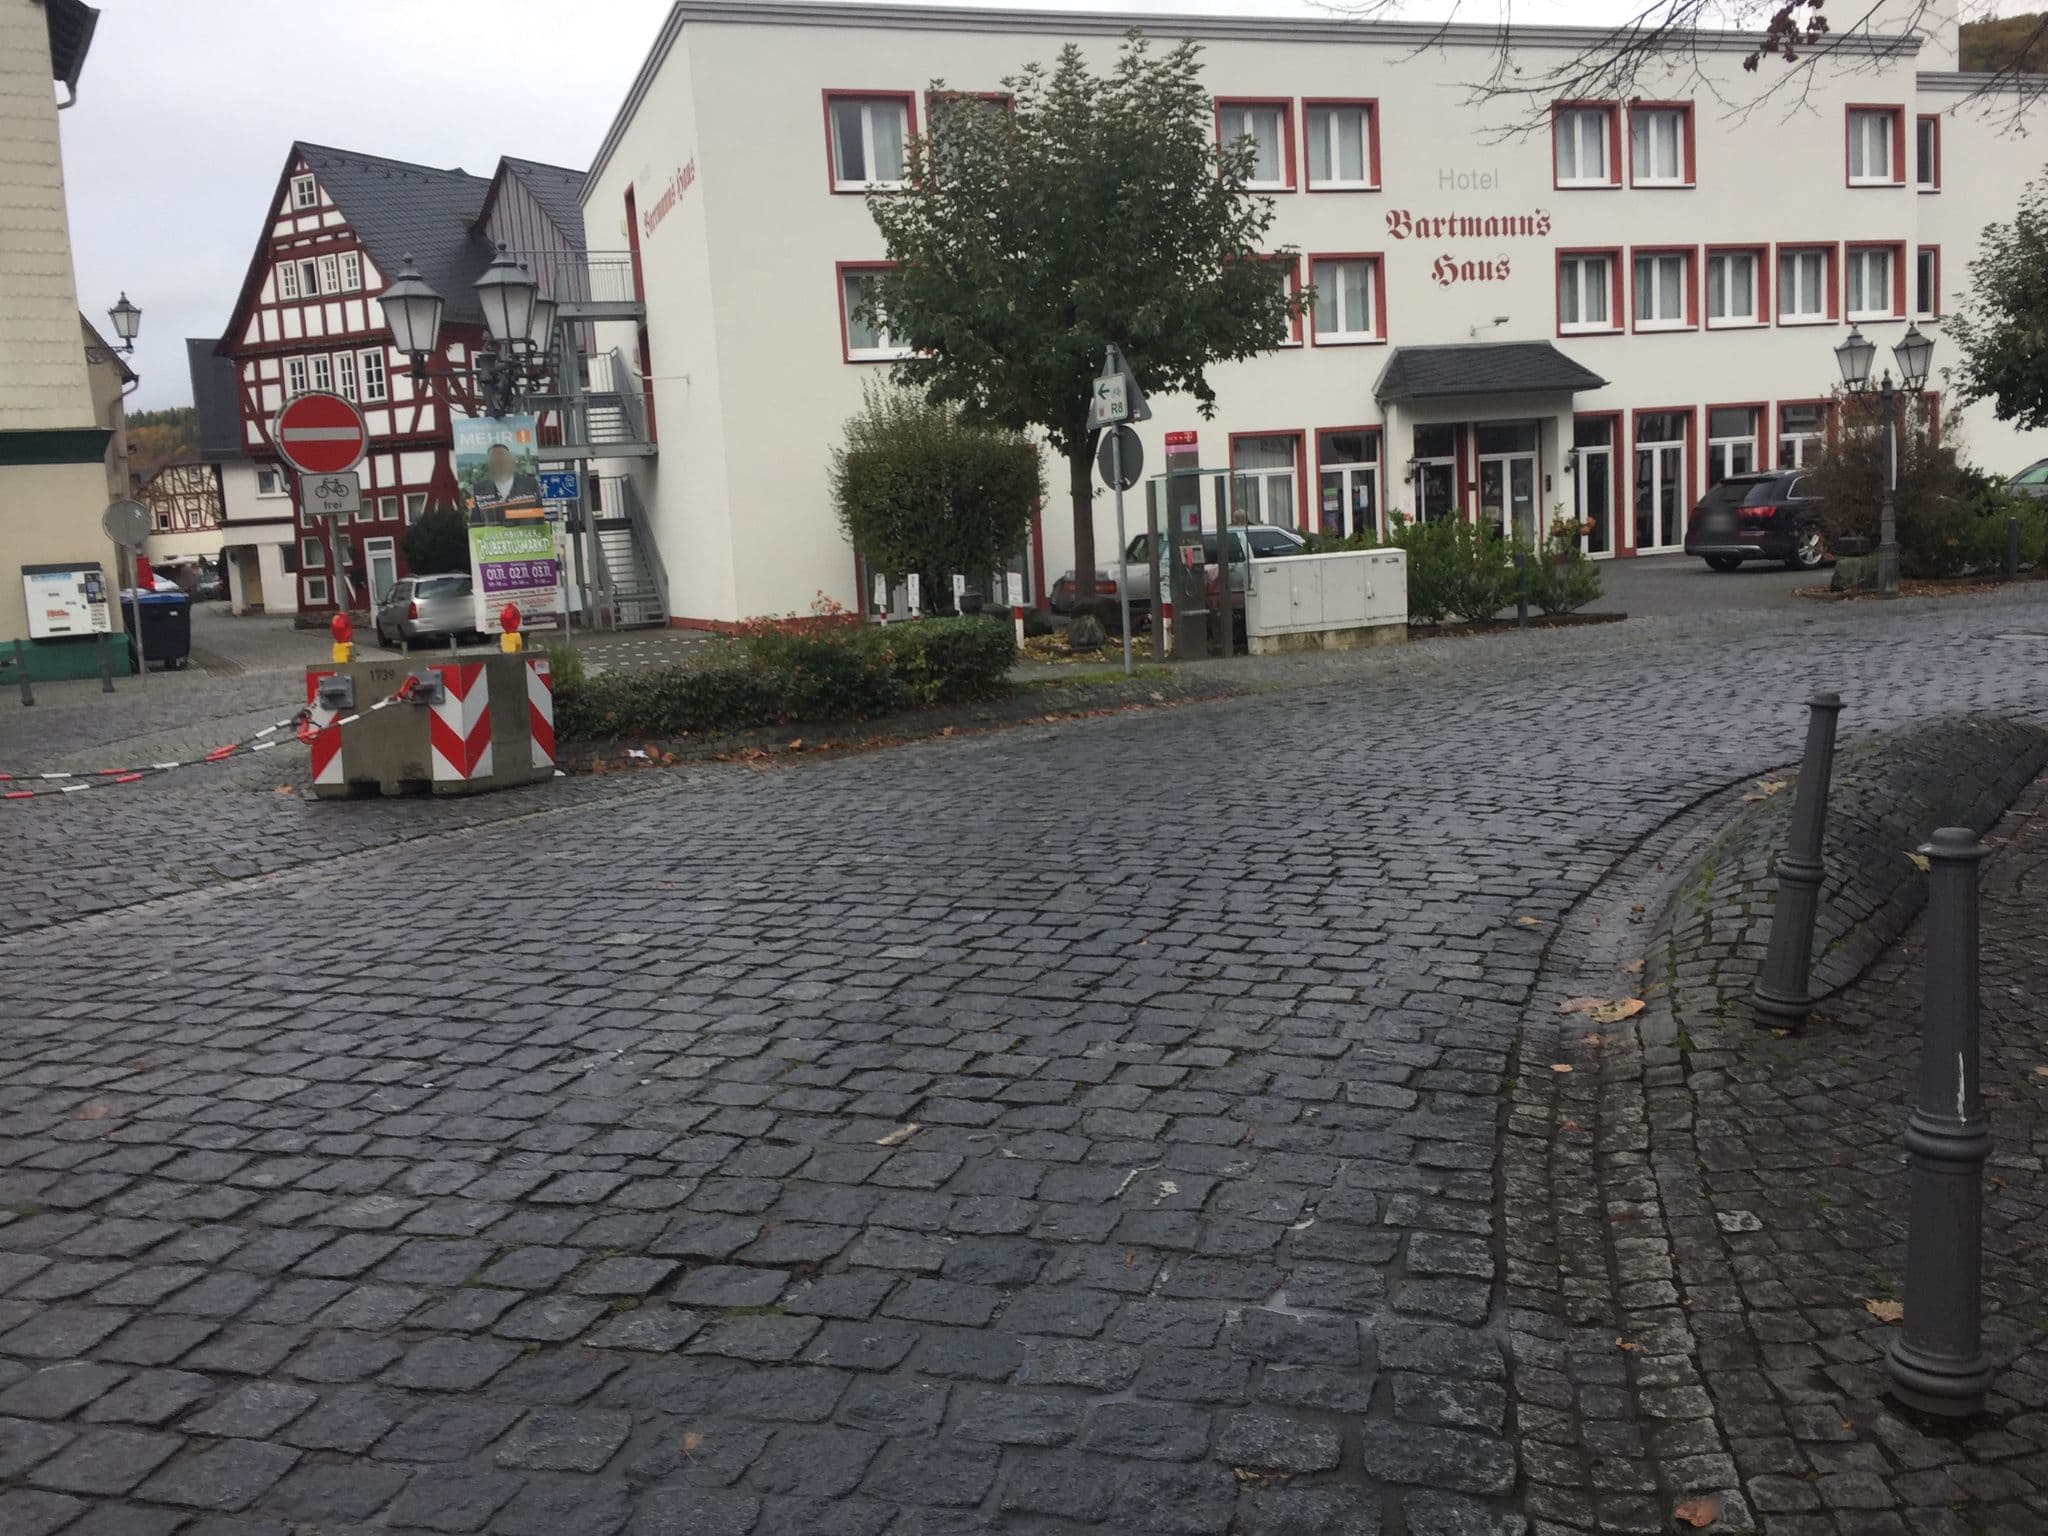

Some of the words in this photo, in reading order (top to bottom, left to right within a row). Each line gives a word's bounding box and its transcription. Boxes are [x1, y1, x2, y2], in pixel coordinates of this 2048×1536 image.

[1438, 167, 1499, 191] Hotel
[1385, 207, 1552, 240] Bartmann's
[1431, 252, 1511, 292] Haus
[1110, 401, 1124, 415] R8
[459, 430, 513, 445] MEHR
[323, 500, 343, 510] frei
